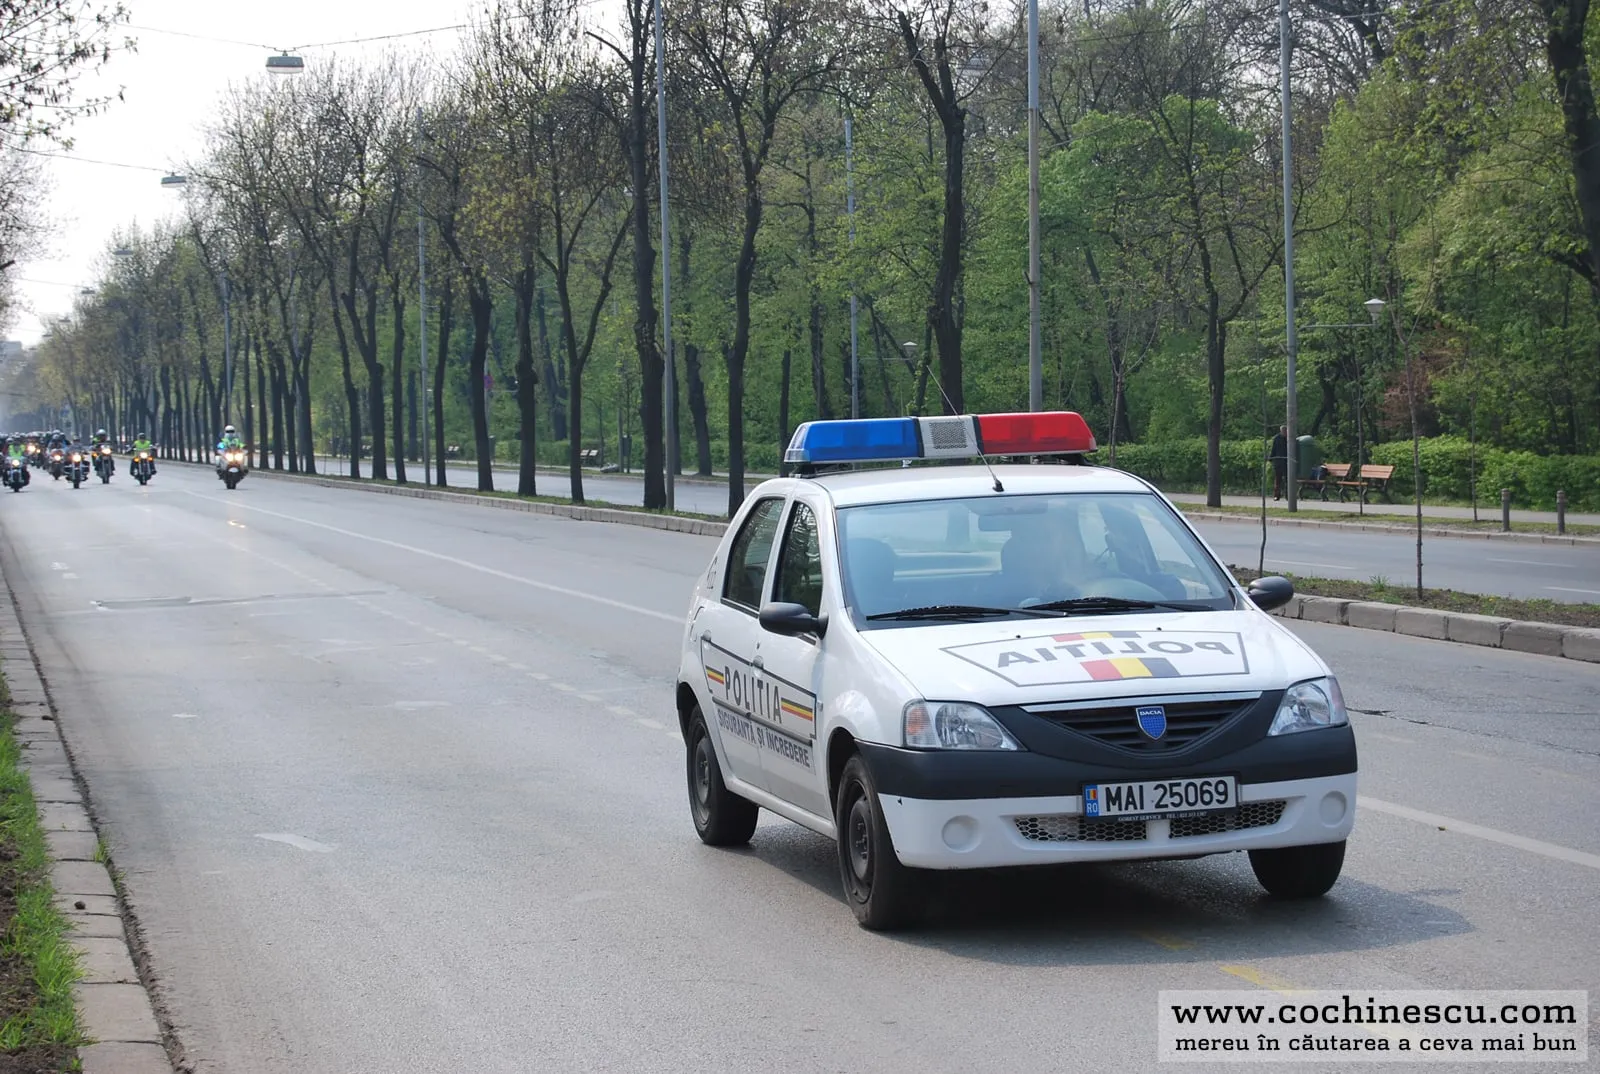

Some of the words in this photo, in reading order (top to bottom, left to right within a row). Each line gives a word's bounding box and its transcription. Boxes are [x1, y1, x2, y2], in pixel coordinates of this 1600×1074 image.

[724, 666, 783, 724] POLITIA
[766, 728, 811, 767] ÎNCREDERE
[1086, 802, 1098, 814] RO
[1104, 785, 1145, 812] MAI
[1153, 779, 1229, 809] 25069
